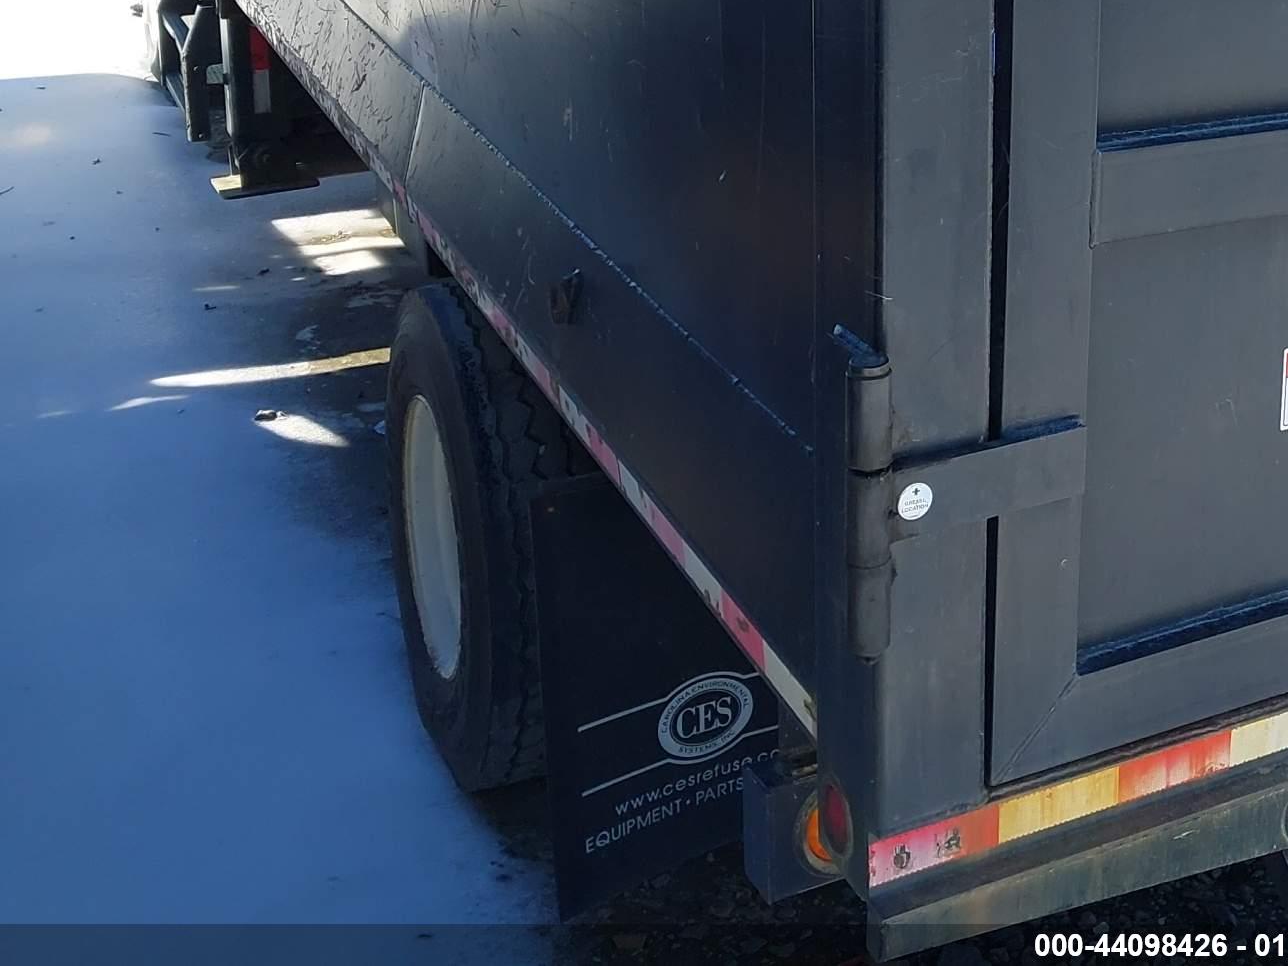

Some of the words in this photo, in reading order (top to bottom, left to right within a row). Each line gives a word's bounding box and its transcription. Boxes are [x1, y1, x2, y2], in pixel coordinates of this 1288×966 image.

[661, 690, 691, 734] CAROLINA
[691, 681, 750, 708] ENVIRONMENTAL
[676, 696, 732, 739] CES
[585, 797, 684, 854] EQUIPMENT
[695, 778, 744, 806] PARTS
